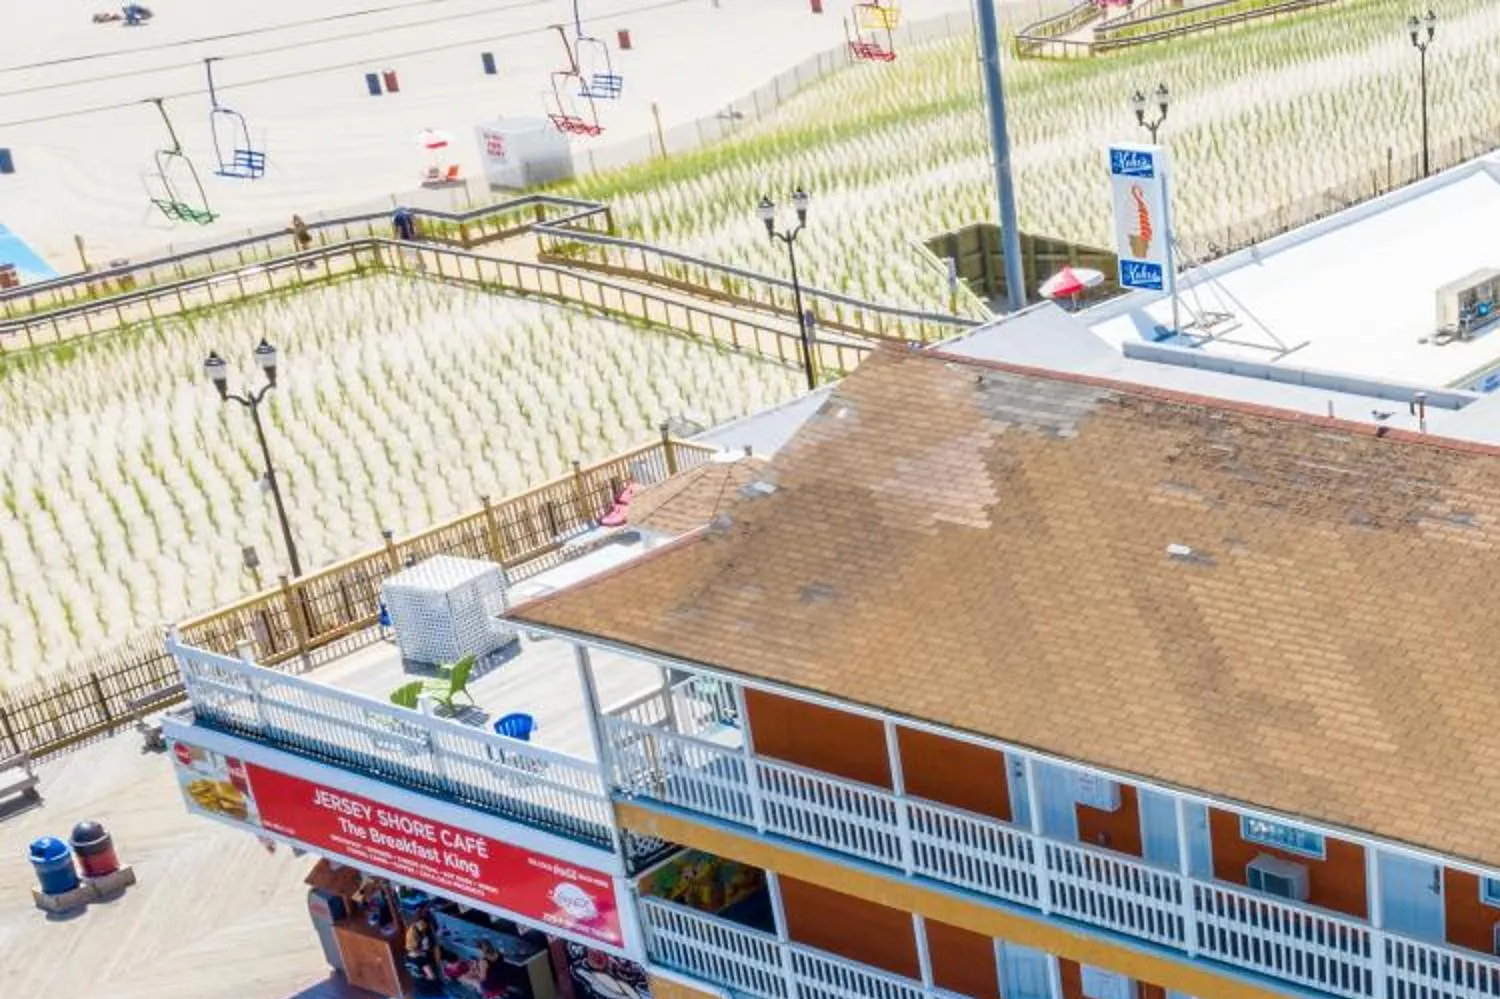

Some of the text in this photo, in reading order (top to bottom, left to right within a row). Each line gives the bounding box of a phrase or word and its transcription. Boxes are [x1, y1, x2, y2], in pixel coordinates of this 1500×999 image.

[314, 788, 490, 859] JERSEY SHORE CAFÉ
[338, 817, 367, 839] The
[369, 827, 442, 863] Breakfast
[443, 852, 481, 878] King
